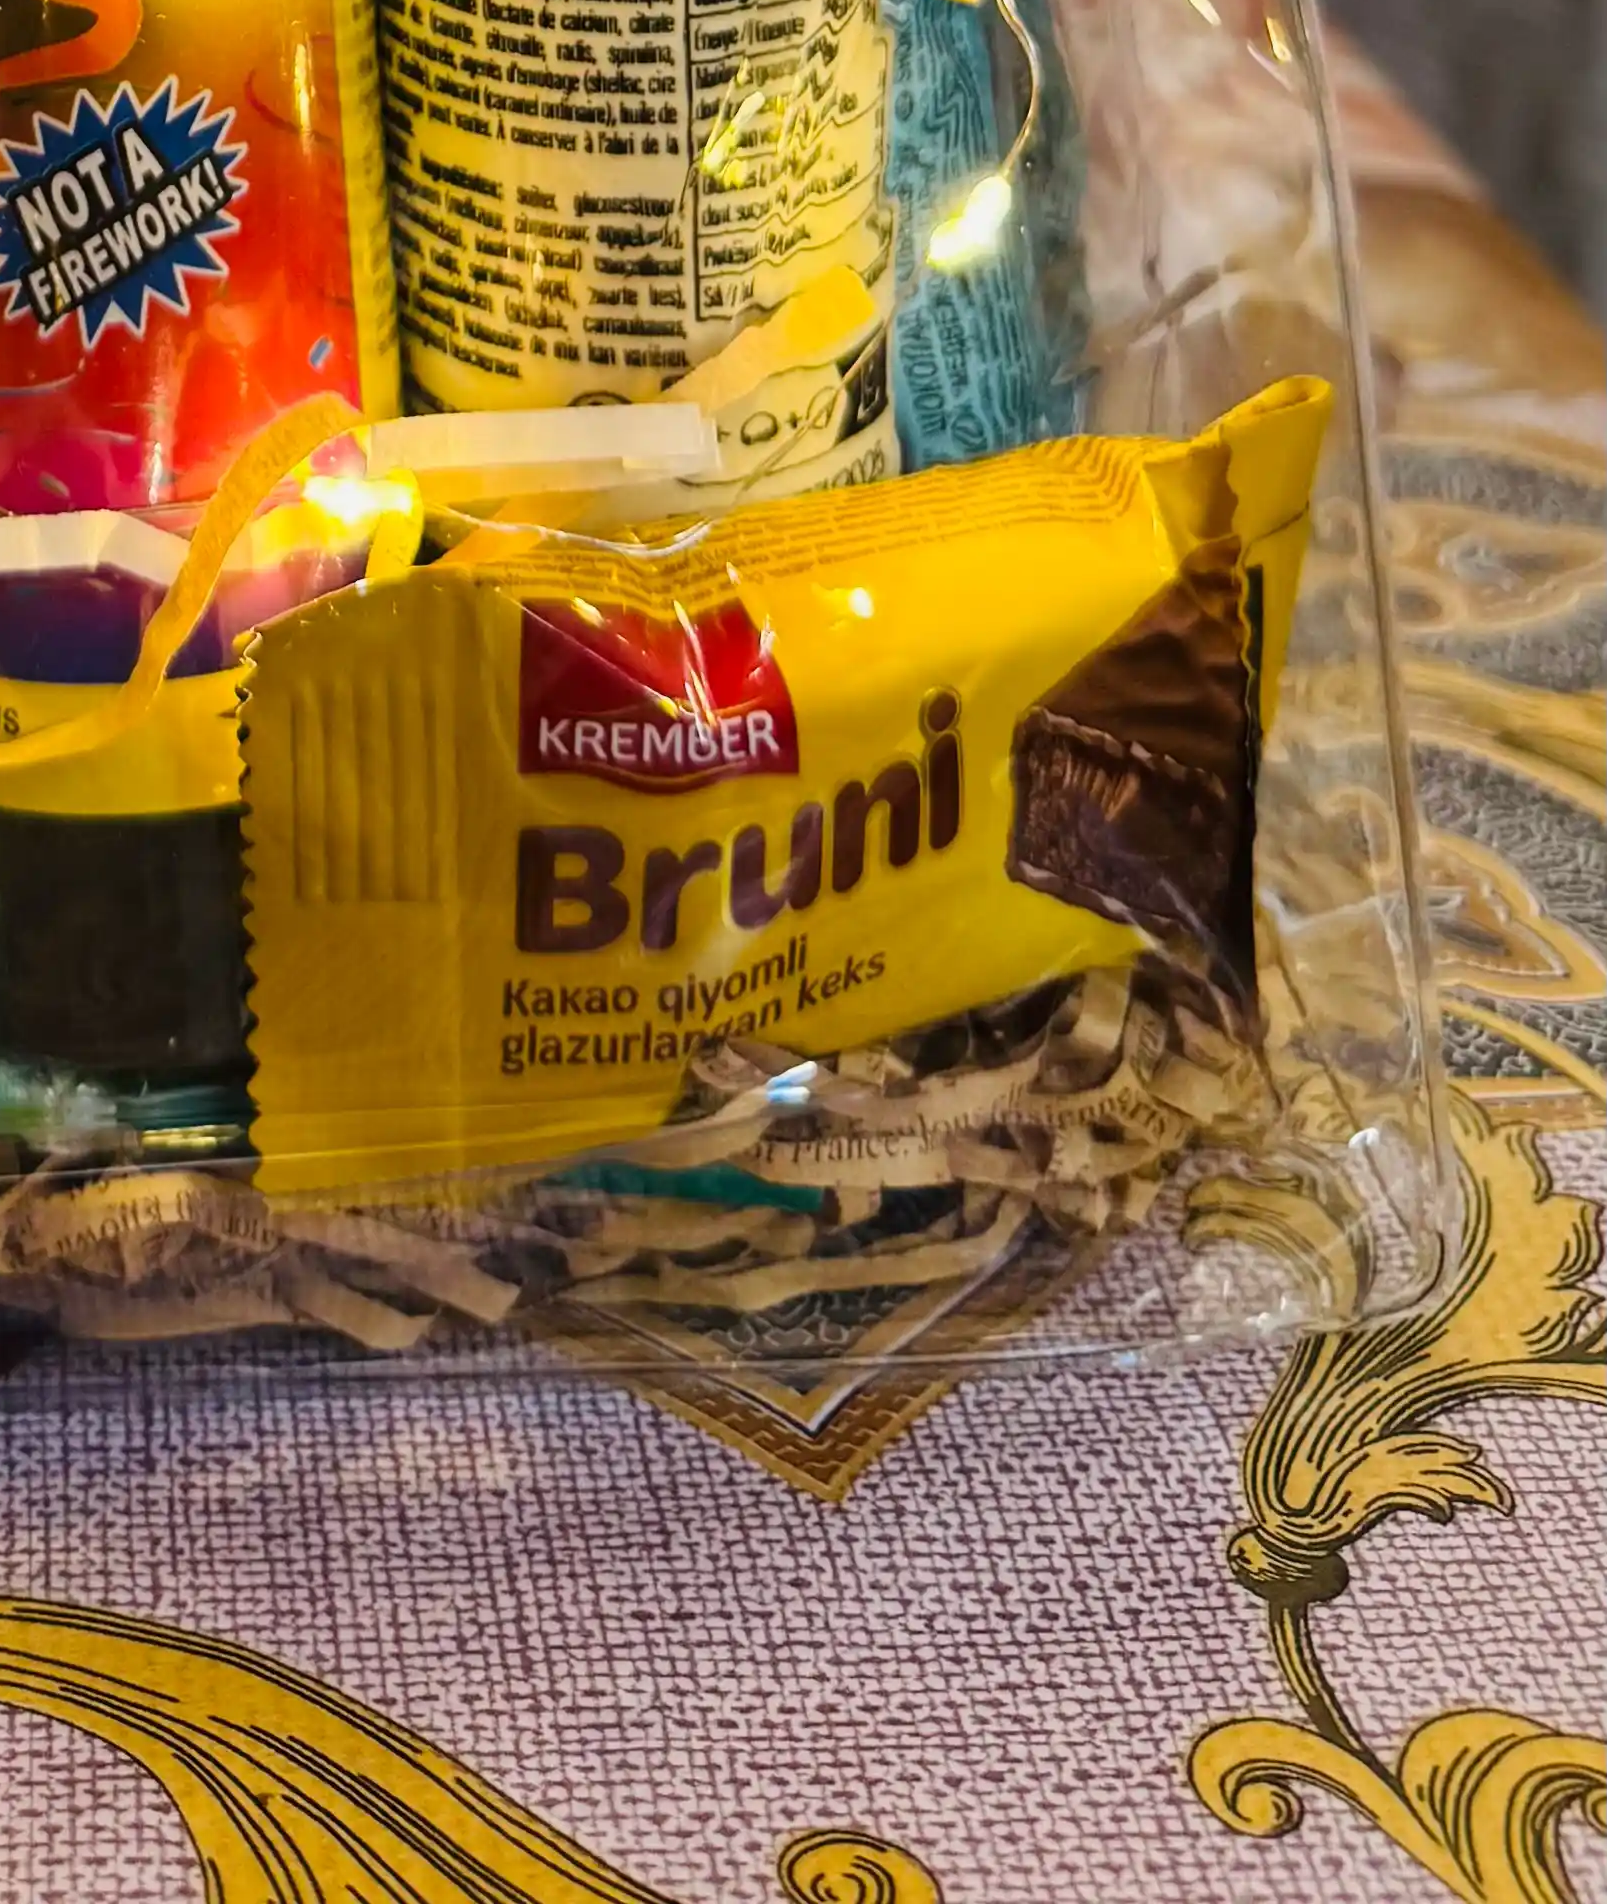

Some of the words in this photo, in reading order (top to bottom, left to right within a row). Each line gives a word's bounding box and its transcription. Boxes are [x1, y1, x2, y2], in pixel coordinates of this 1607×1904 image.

[15, 147, 116, 253] NOT
[122, 126, 165, 192] A
[640, 131, 660, 156] de
[28, 156, 225, 318] FIREWORK!
[537, 708, 781, 765] KREMBER
[514, 685, 962, 954] Bruni
[501, 978, 639, 1019] Kakao
[657, 933, 808, 1025] qiyomli
[501, 997, 784, 1077] glazurlangan
[795, 949, 888, 1013] keks
